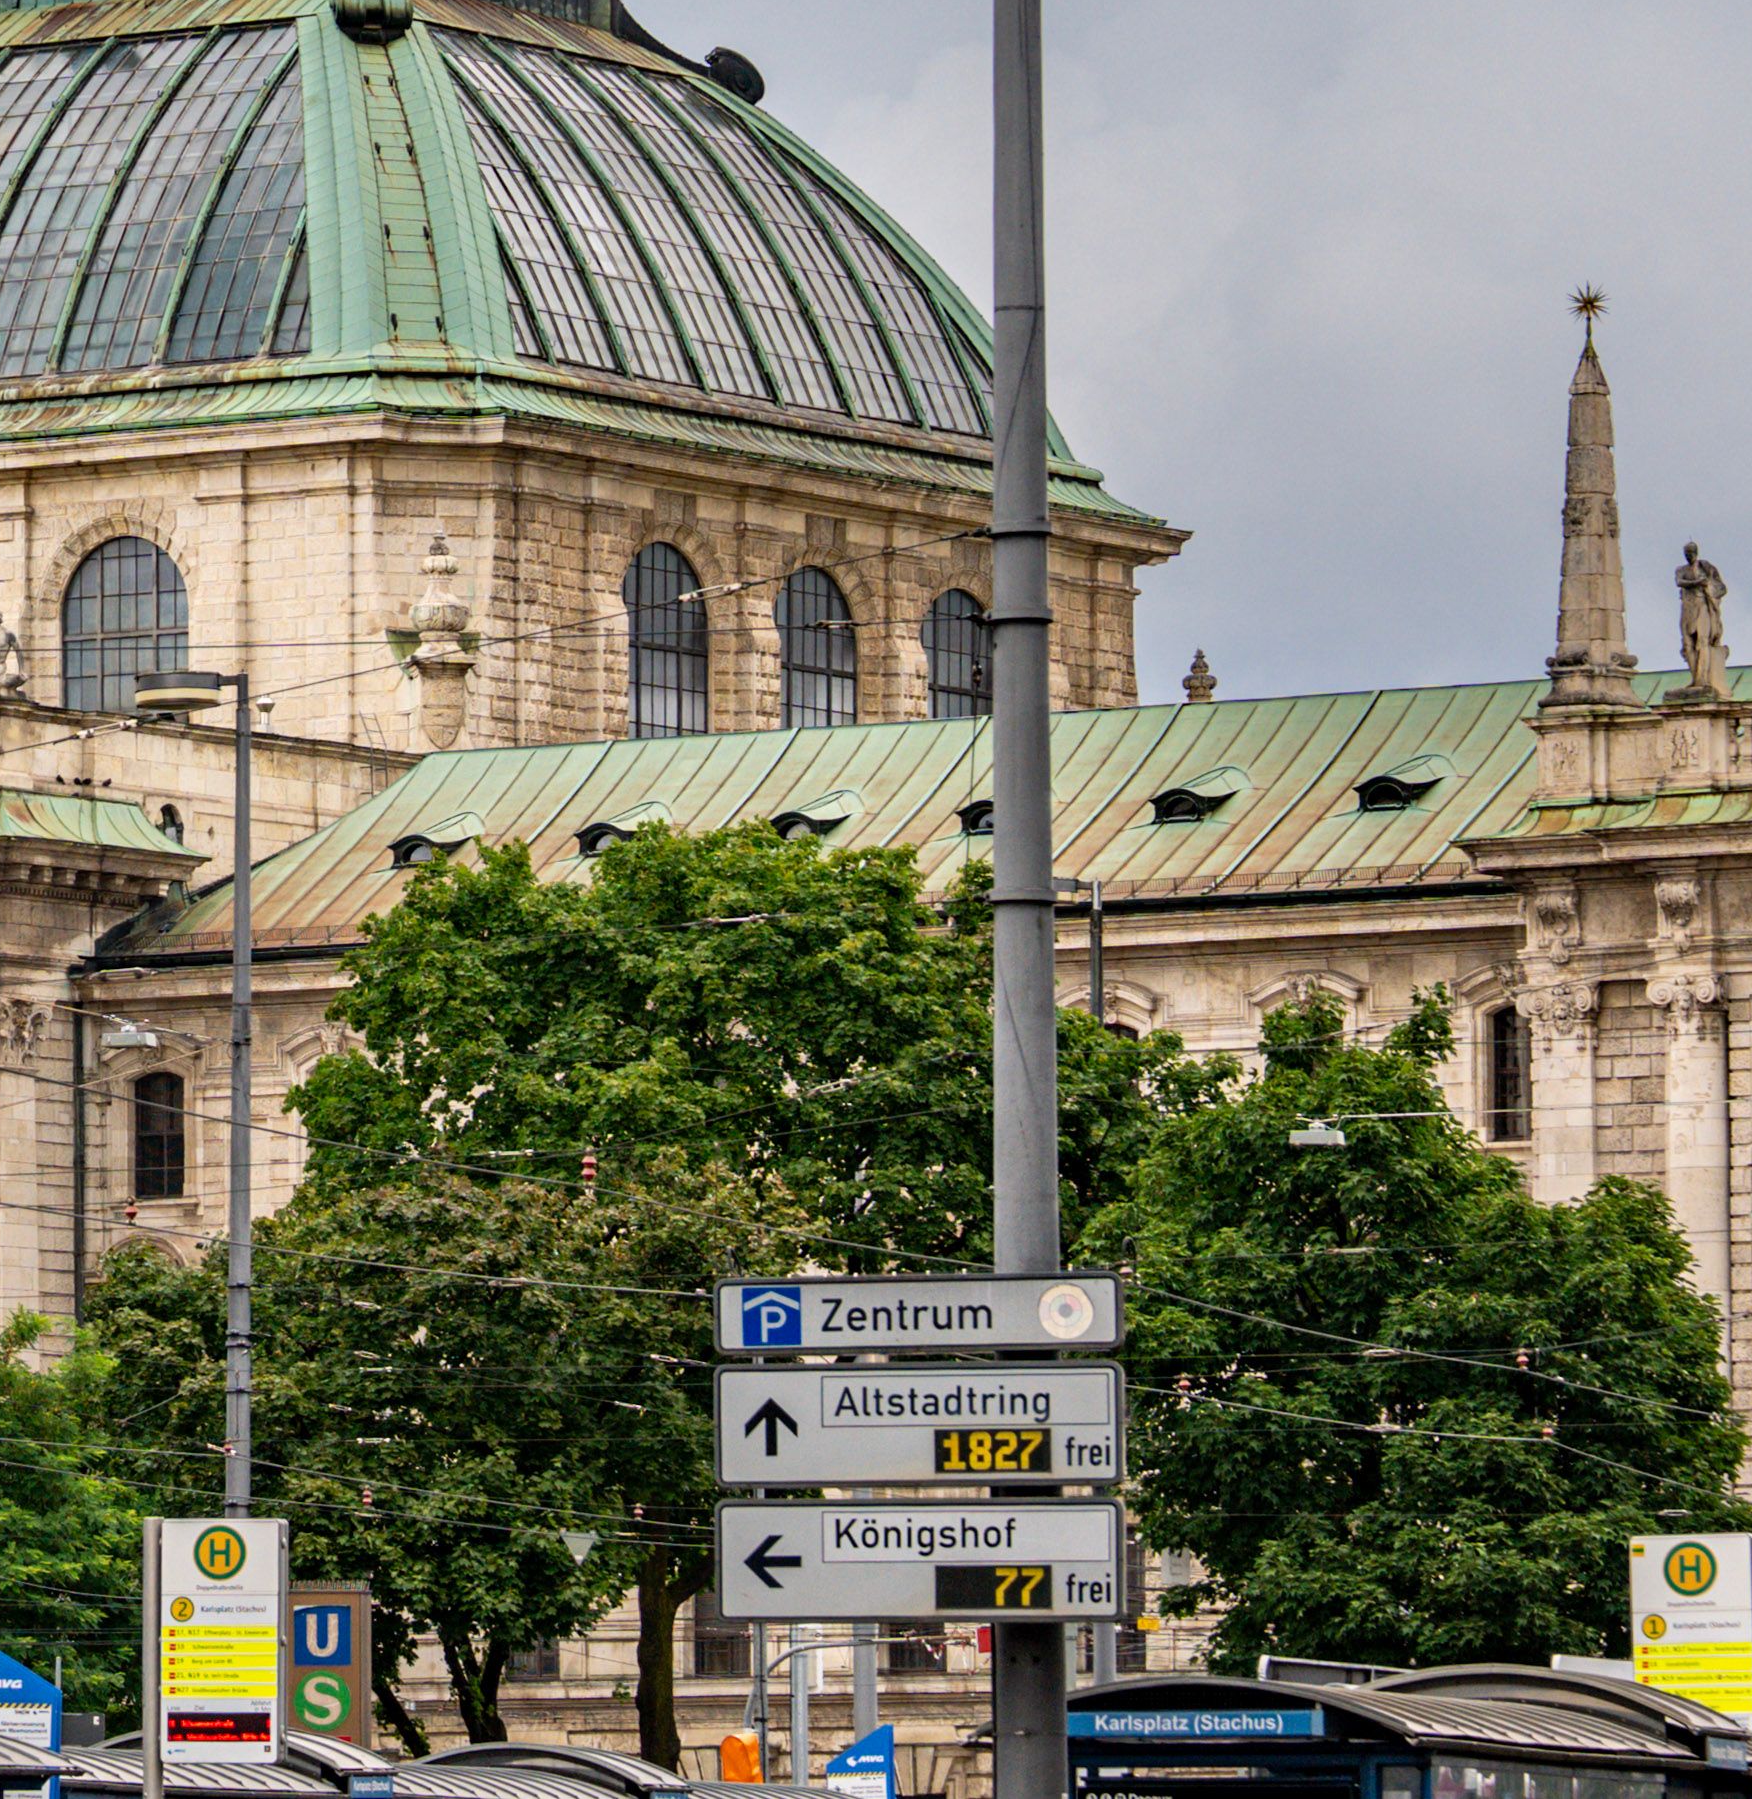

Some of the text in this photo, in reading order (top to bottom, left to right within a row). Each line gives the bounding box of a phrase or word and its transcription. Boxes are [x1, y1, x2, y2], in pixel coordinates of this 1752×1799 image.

[821, 1298, 993, 1333] Zentrum
[834, 1385, 1051, 1423] Altstadtring
[942, 1431, 1043, 1470] 1827
[1065, 1435, 1112, 1467] frei
[209, 1538, 231, 1567] H
[835, 1517, 1016, 1556] Königshof
[1678, 1554, 1702, 1584] H
[995, 1567, 1045, 1606] 77
[1066, 1573, 1112, 1604] frei
[178, 1601, 188, 1617] 2
[306, 1612, 339, 1658] U
[1649, 1619, 1660, 1635] 1
[303, 1675, 343, 1726] S
[1095, 1713, 1283, 1735] Karlsplatz (Stachus)
[858, 1754, 885, 1764] MVG
